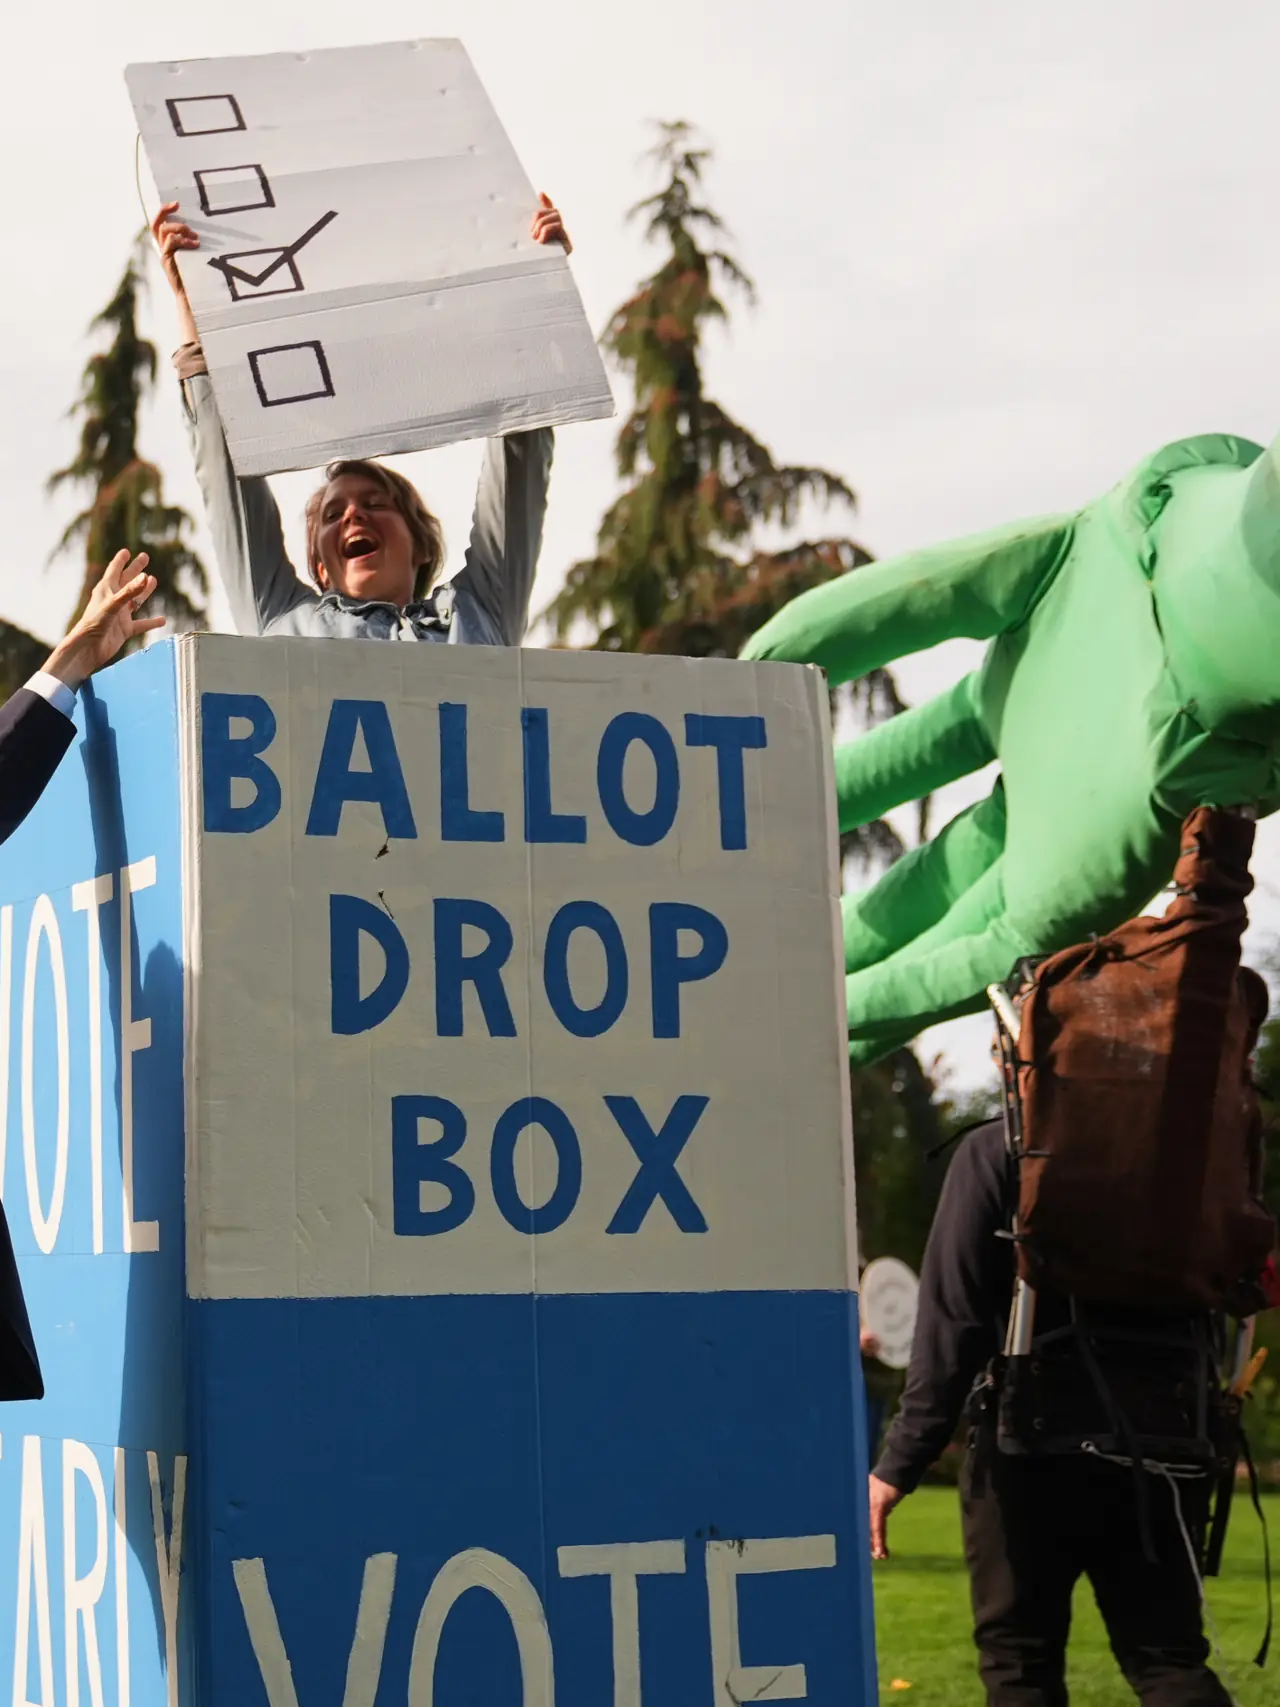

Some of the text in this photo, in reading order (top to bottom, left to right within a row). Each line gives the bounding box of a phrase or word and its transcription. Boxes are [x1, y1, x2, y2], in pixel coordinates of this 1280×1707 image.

[201, 692, 767, 850] BALLOT
[329, 894, 728, 1039] DROP
[391, 1095, 710, 1237] BOX
